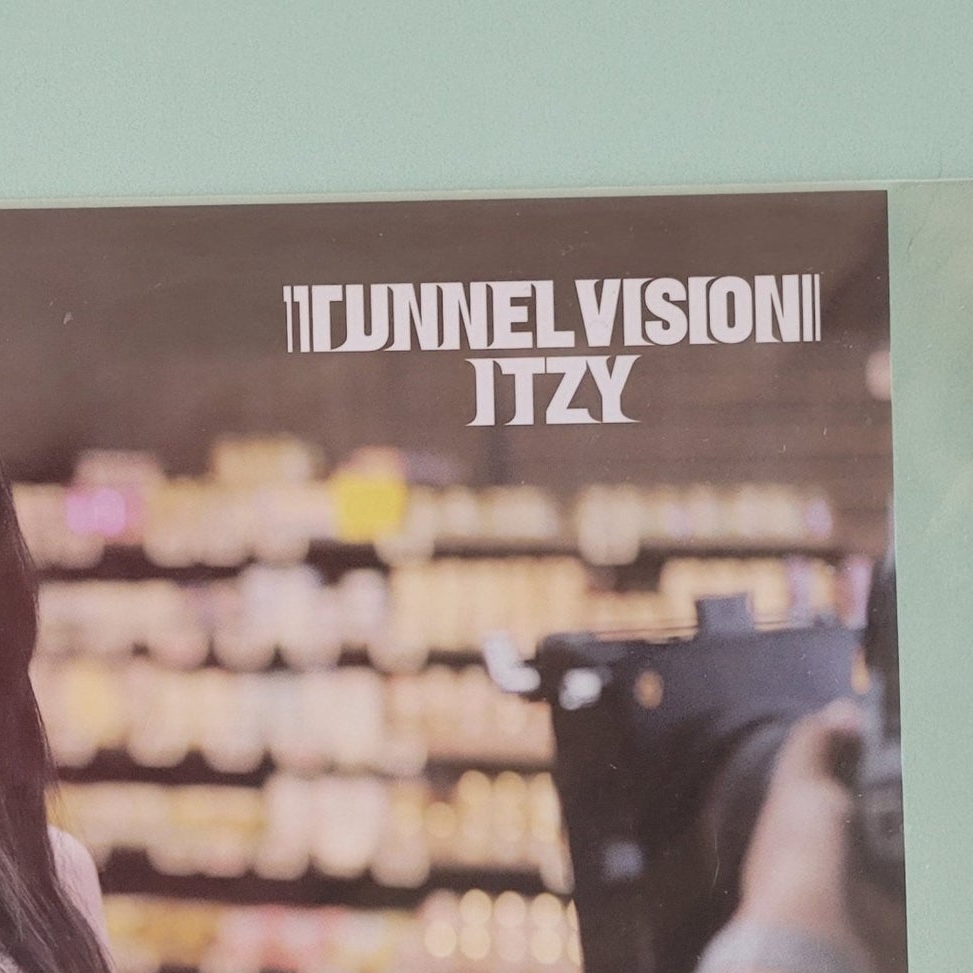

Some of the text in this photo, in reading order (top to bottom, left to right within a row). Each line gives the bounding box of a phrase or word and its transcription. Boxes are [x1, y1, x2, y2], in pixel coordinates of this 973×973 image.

[310, 274, 801, 352] TUNNEL VISION
[464, 354, 641, 427] ITZY
